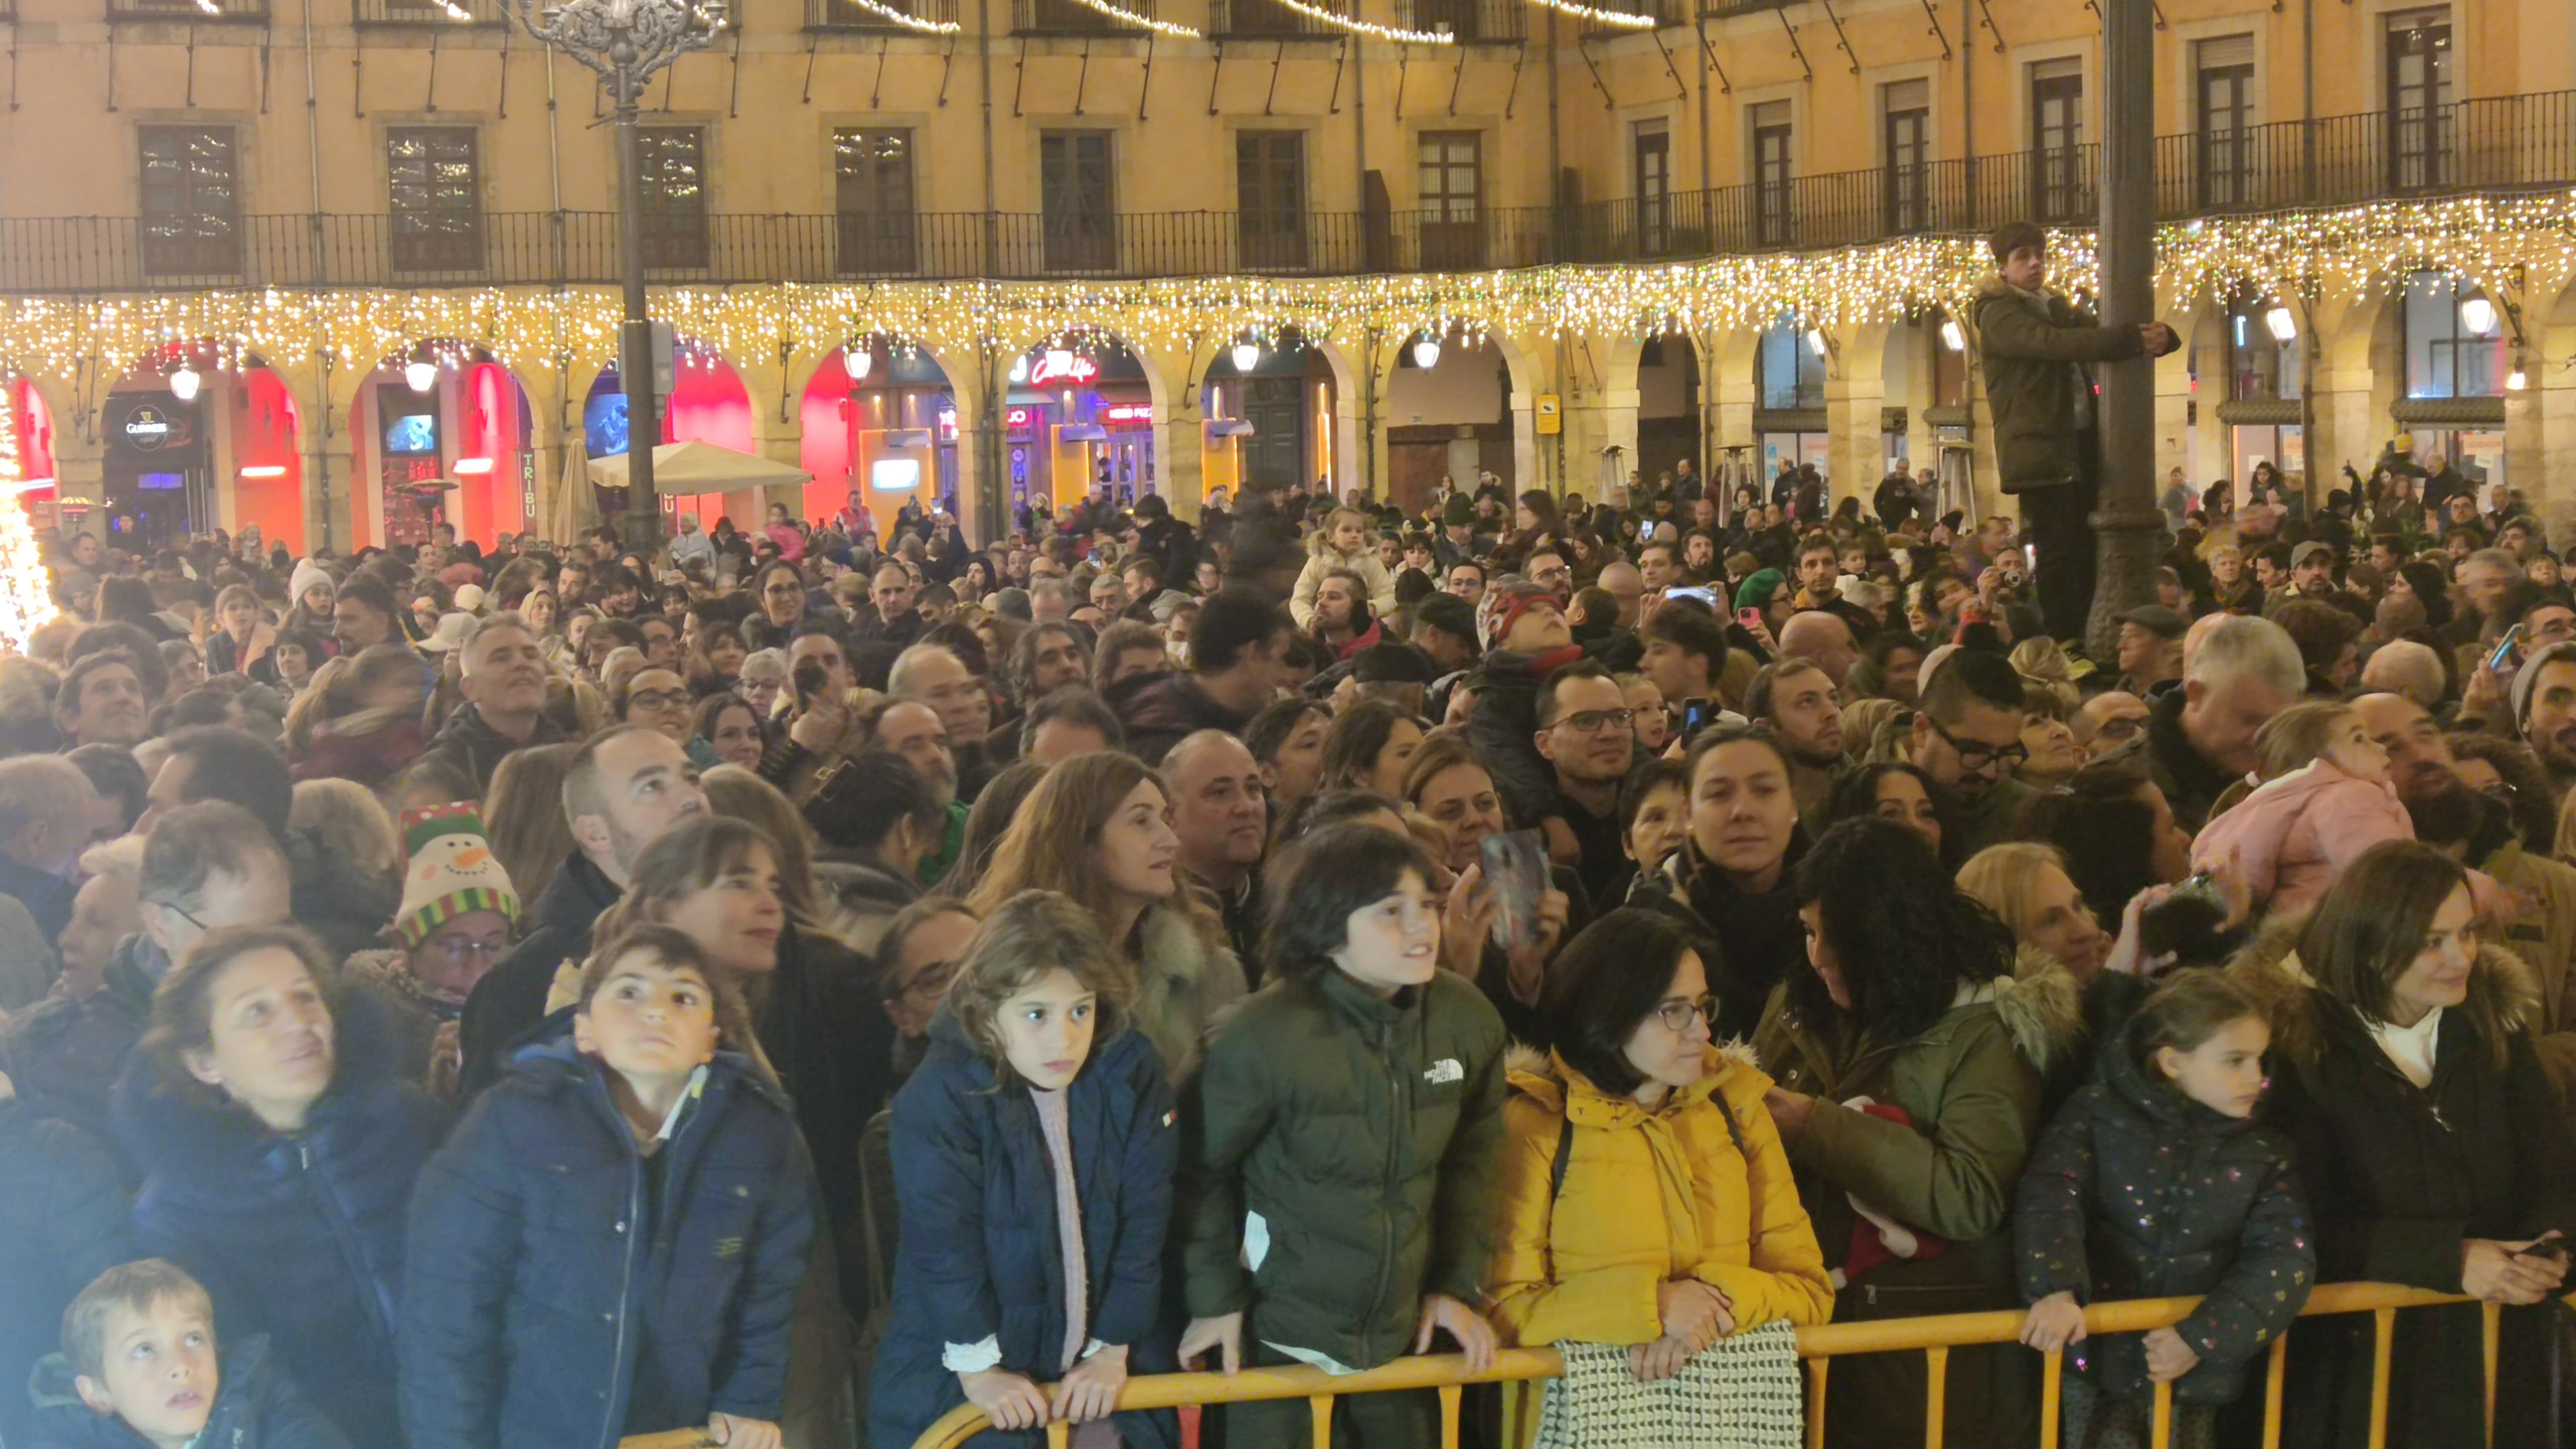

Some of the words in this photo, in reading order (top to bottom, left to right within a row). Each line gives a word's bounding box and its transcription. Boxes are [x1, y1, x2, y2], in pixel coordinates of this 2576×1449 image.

[523, 454, 535, 518] TRIBU
[1433, 1060, 1449, 1069] THE
[1423, 1068, 1450, 1081] NORTH
[1432, 1074, 1450, 1085] FACE
